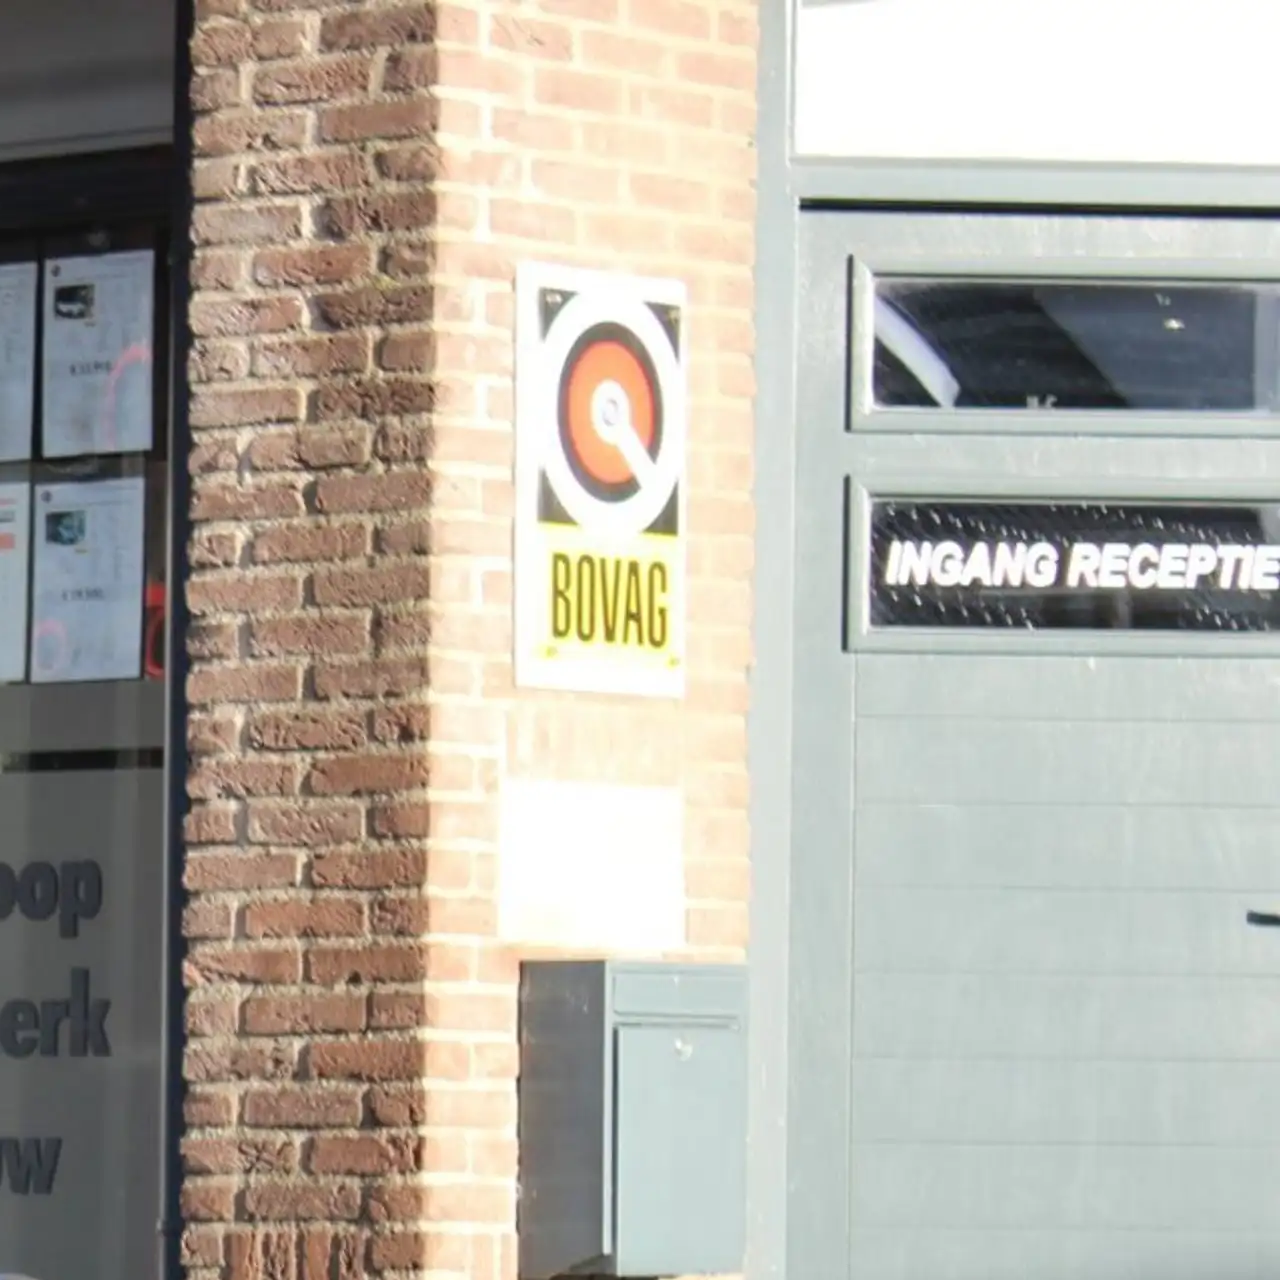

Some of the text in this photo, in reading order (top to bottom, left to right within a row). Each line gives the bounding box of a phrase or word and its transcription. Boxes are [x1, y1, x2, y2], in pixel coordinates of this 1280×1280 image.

[550, 552, 670, 649] BOVAG
[885, 539, 1280, 590] INGANG RECEPTIE
